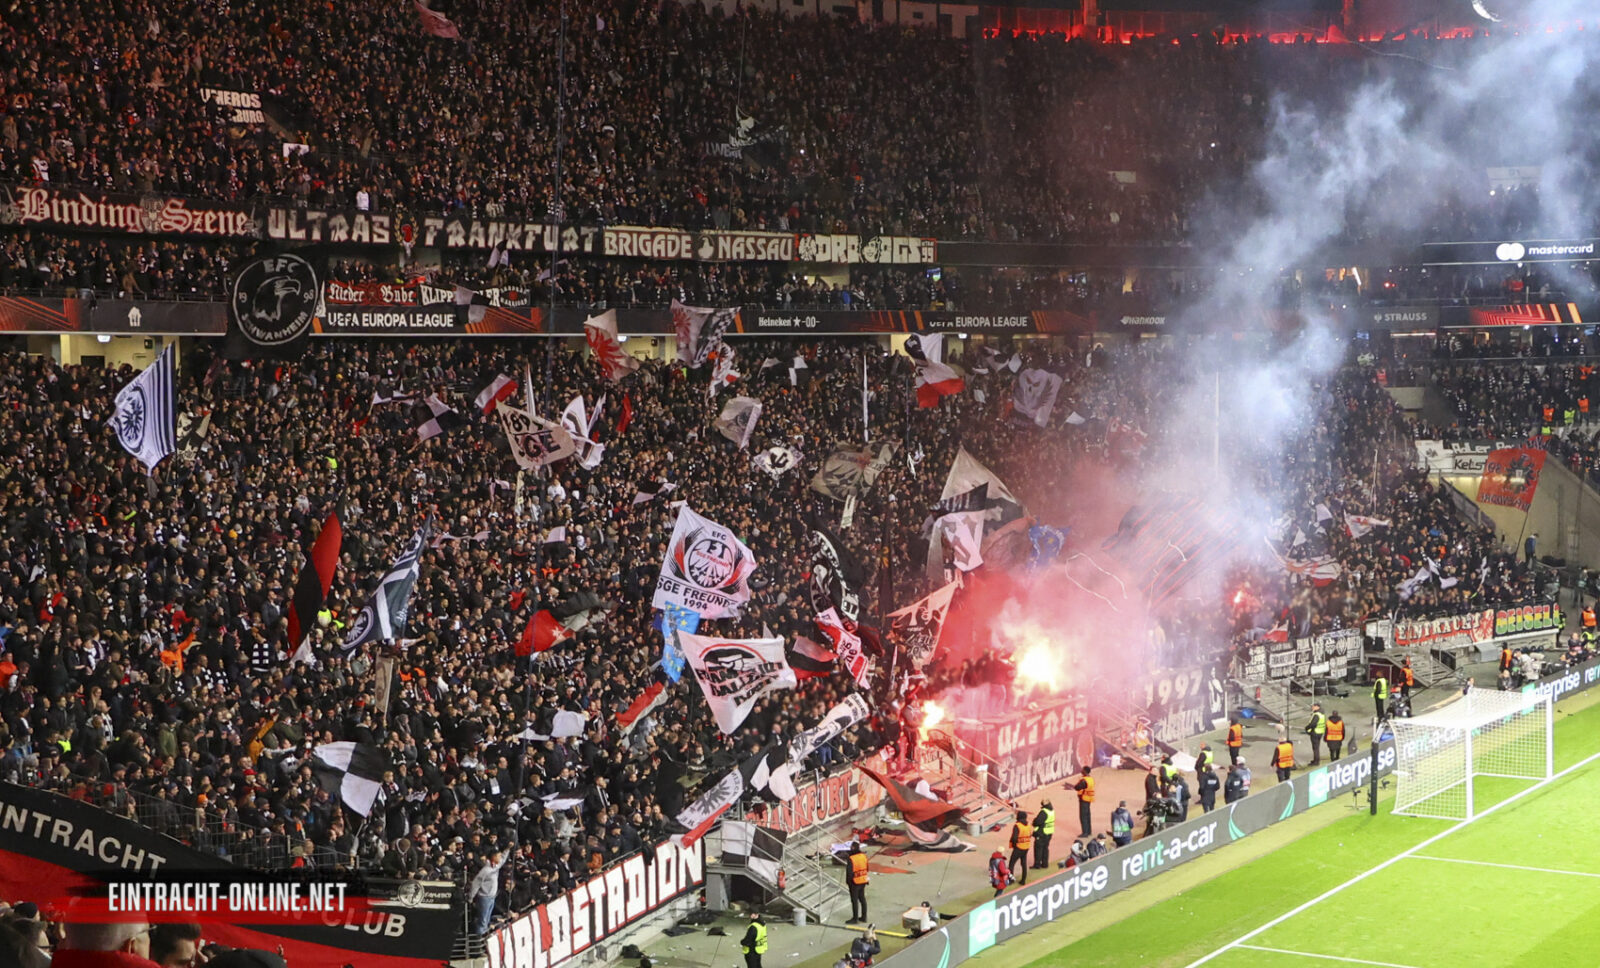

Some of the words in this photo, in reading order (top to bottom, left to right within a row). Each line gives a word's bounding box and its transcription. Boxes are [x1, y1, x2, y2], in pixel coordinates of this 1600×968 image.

[16, 186, 145, 233] Binding
[161, 199, 249, 236] Szene
[268, 208, 390, 243] ULTRAS
[424, 218, 599, 252] FRANKFURT
[604, 232, 692, 258] BRIGADE
[718, 236, 792, 260] NASSAU
[1528, 243, 1594, 255] mastercard
[263, 259, 300, 273] EFC
[327, 312, 360, 327] UEFA
[362, 313, 407, 327] EUROPA
[411, 313, 454, 327] LEAGUE
[758, 316, 792, 327] Heineken
[956, 316, 990, 327] EUROPA
[992, 316, 1028, 327] LEAGUE
[1384, 312, 1427, 321] STRAUSS
[711, 530, 727, 541] EFC
[684, 598, 708, 610] 1994
[1144, 670, 1203, 709] 1997
[998, 702, 1088, 756] ULTRAS
[998, 738, 1074, 799] Eintracht
[1313, 746, 1395, 797] enterprse
[0, 802, 167, 879] NTRACHT
[973, 864, 1109, 942] enterprise
[1122, 821, 1218, 880] rent-a-car
